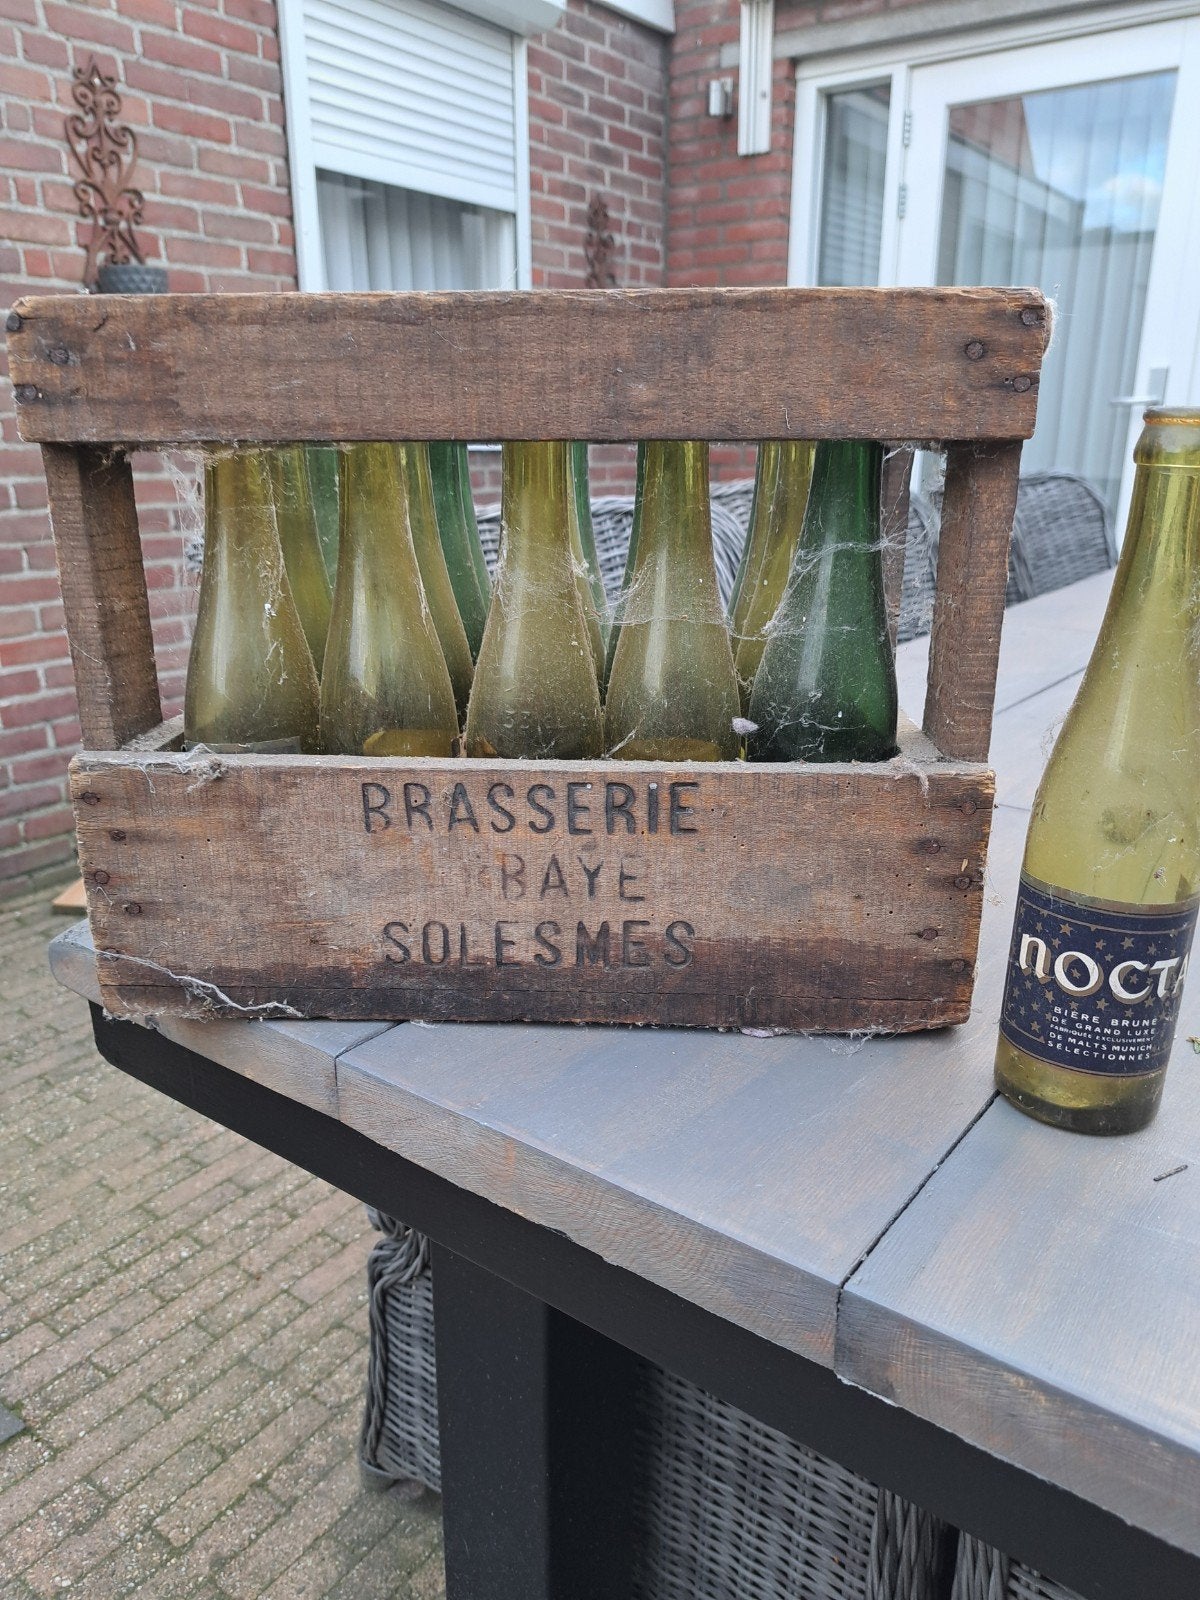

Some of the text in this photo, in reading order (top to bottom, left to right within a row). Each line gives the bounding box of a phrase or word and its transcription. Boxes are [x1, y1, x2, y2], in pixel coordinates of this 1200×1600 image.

[361, 782, 699, 835] BRASSERIE
[501, 853, 646, 901] BAYE
[382, 920, 696, 969] SOLESMES
[1049, 1032, 1152, 1052] DE MALTS MUNICH
[1052, 1016, 1067, 1025] DE
[1075, 1023, 1121, 1035] GRAND
